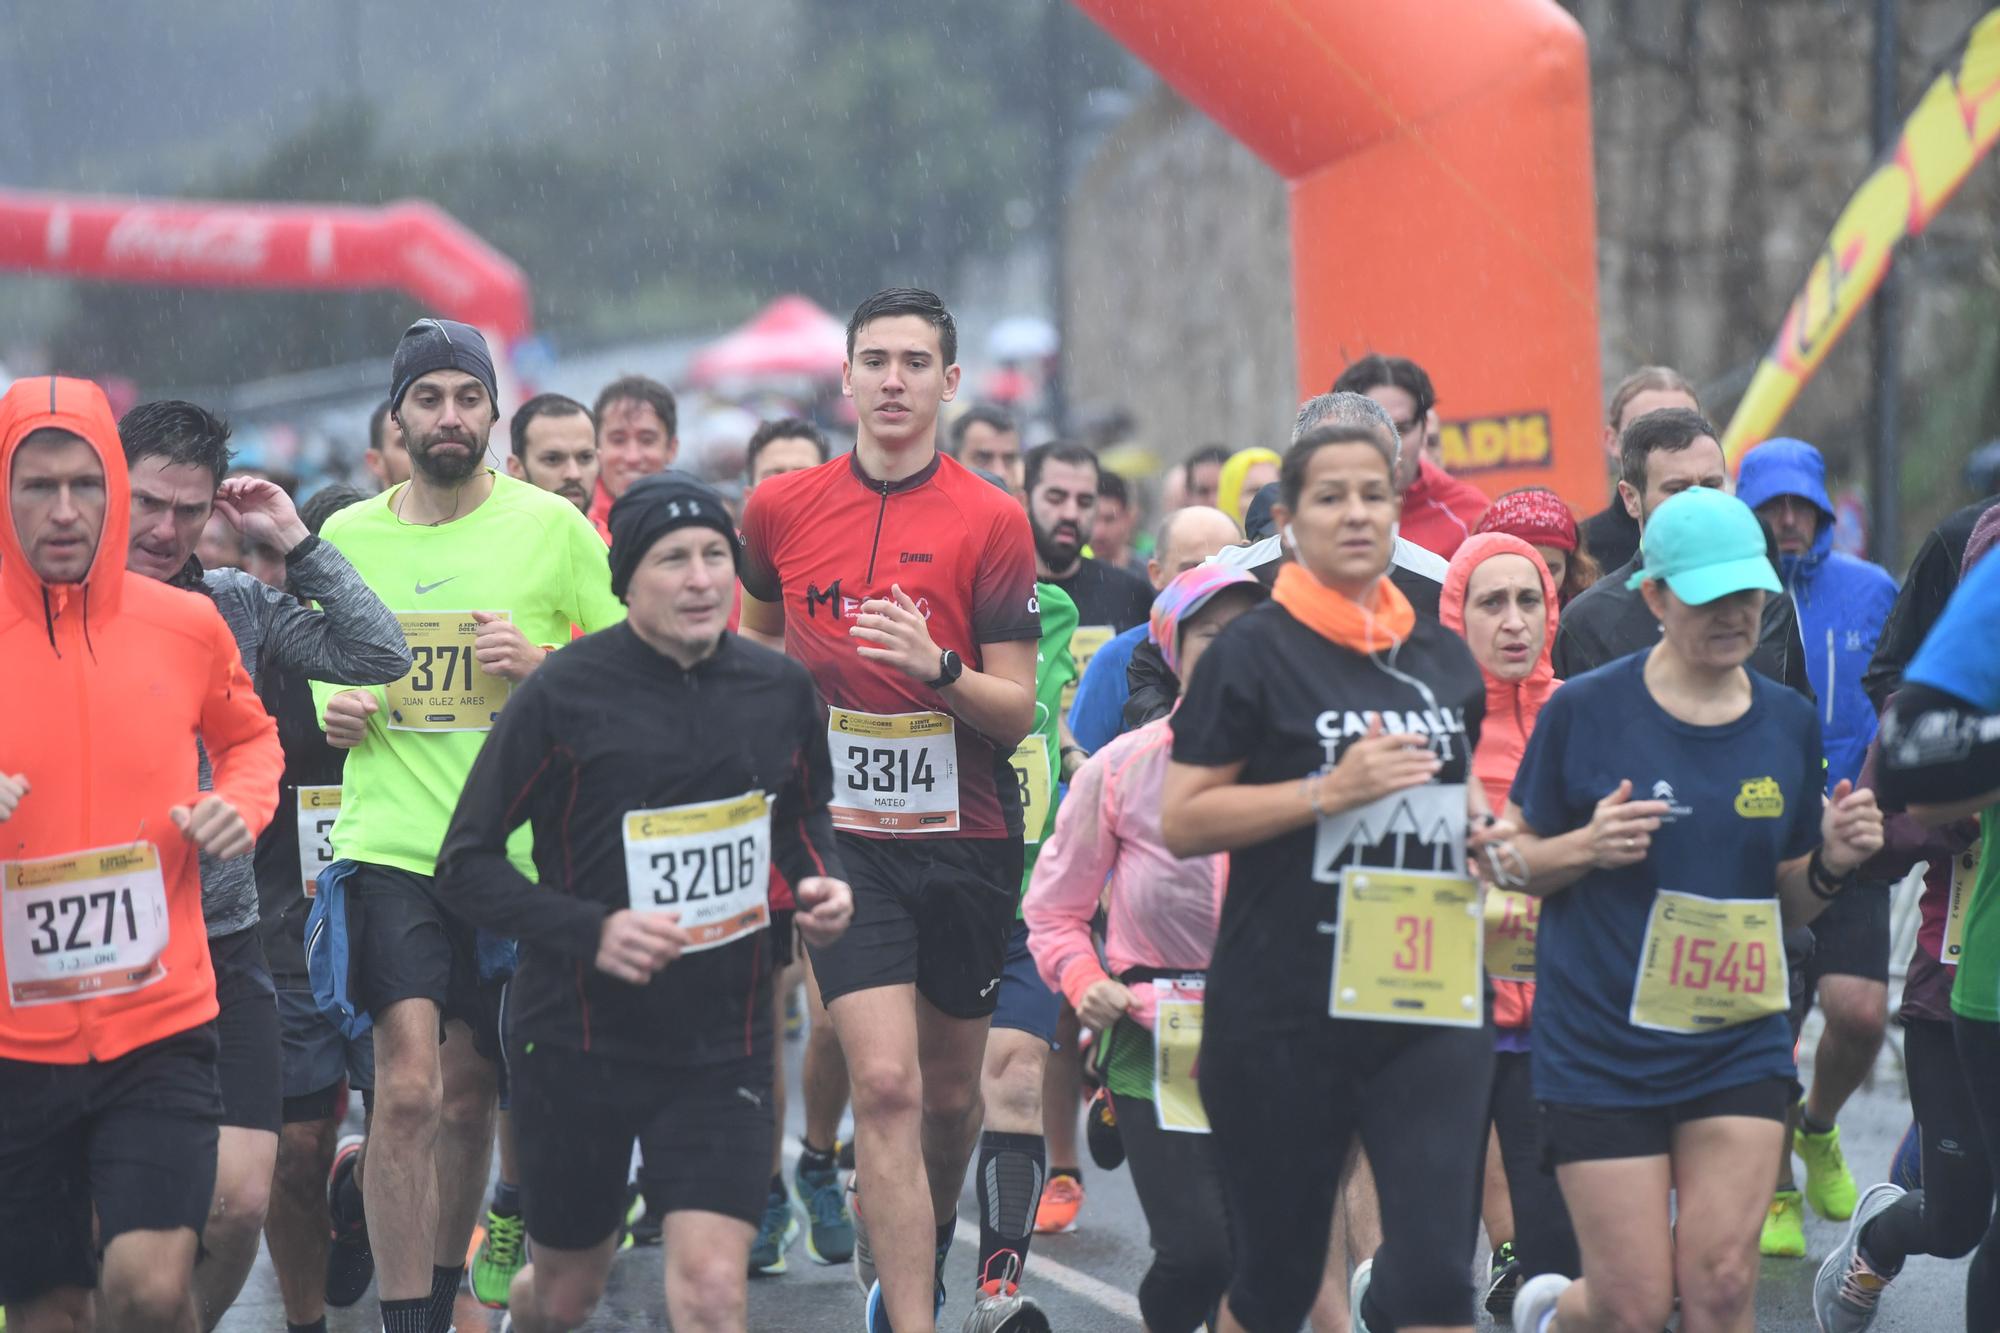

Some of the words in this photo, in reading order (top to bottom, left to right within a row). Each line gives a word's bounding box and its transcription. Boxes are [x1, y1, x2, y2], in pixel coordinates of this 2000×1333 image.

[412, 646, 471, 691] 371
[402, 697, 423, 706] JUAN
[429, 697, 454, 706] GLEZ
[459, 697, 485, 706] ARES
[847, 746, 935, 793] 3314
[874, 798, 906, 807] MATEO
[651, 835, 755, 905] 3206
[26, 888, 138, 956] 3271
[1393, 915, 1435, 973] 31
[1669, 934, 1767, 994] 1549
